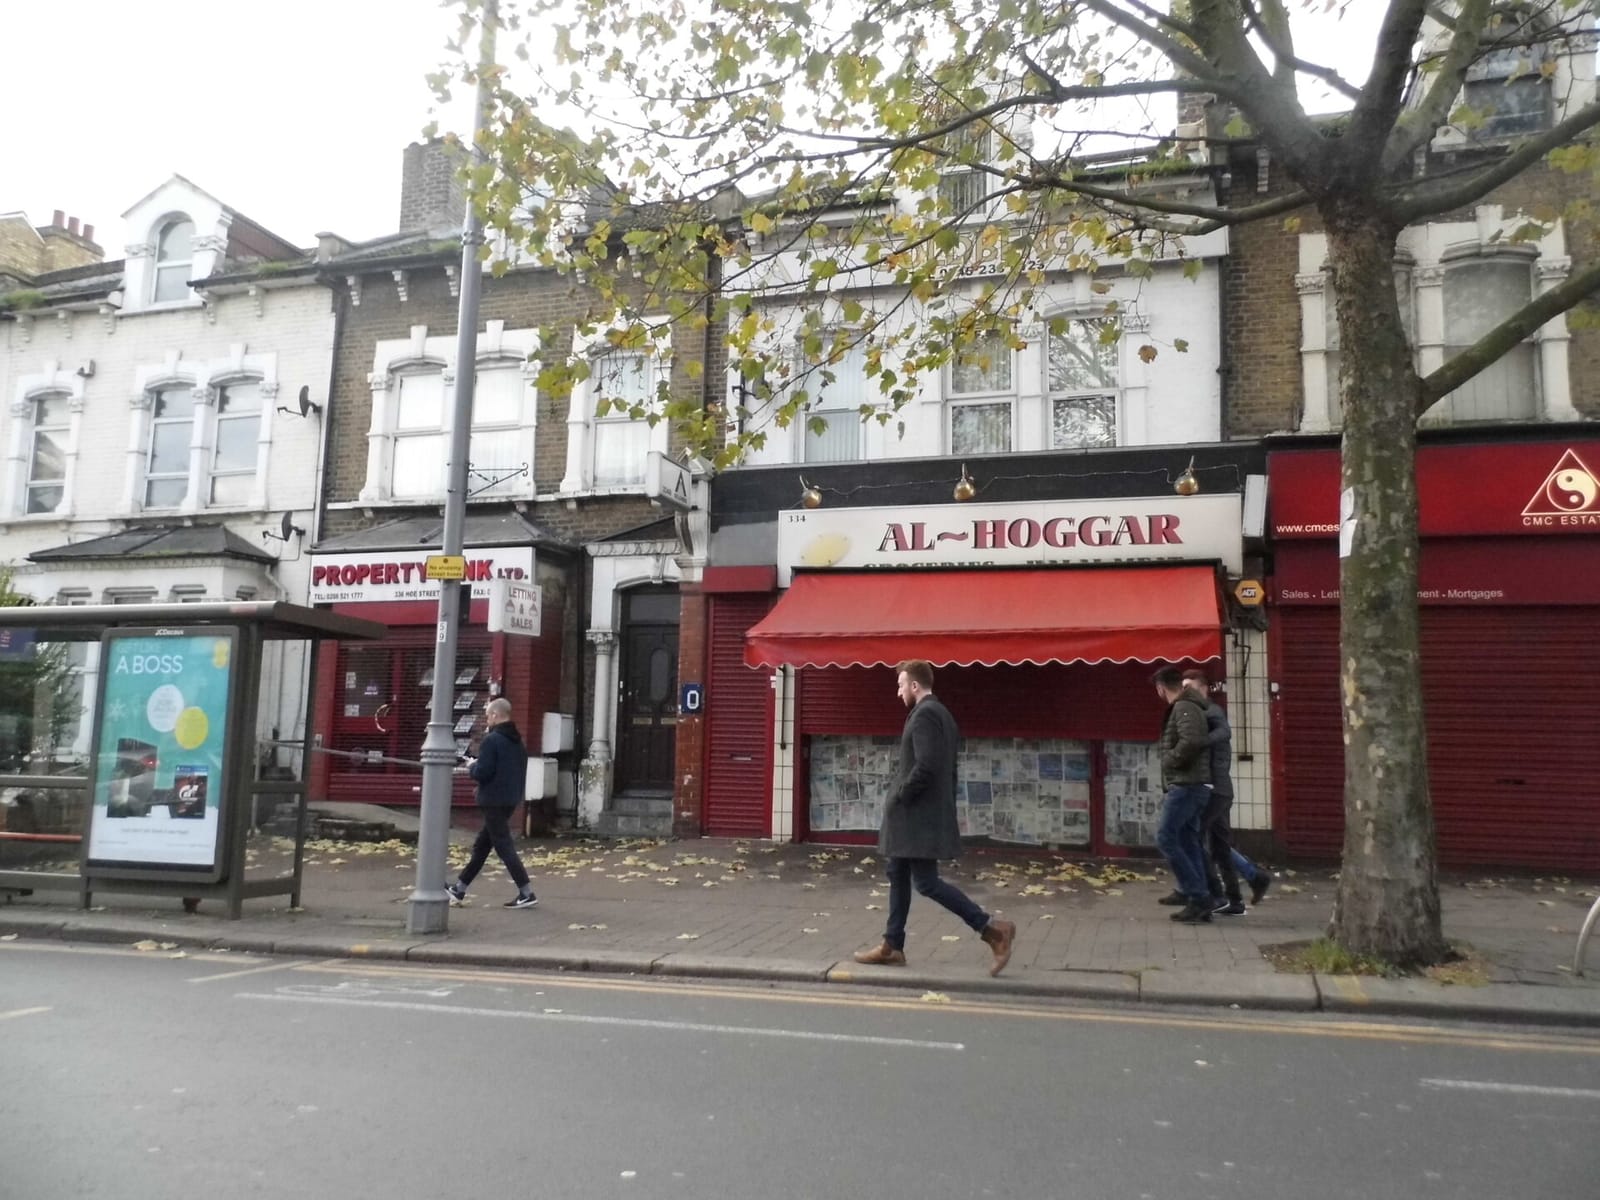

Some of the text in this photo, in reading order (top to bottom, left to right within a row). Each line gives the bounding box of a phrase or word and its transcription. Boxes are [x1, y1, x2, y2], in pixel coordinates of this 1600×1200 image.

[789, 514, 806, 523] 334
[1522, 515, 1600, 526] CMC ESTA
[1276, 524, 1340, 533] www.cmces
[312, 562, 427, 587] PROPERTY
[497, 567, 529, 580] LTD.
[418, 589, 440, 597] STREET
[508, 586, 537, 602] LETTING
[1281, 589, 1310, 599] Sales
[1320, 589, 1340, 599] Lett
[1447, 589, 1503, 600] Mortgages
[510, 616, 533, 630] SALES
[115, 654, 184, 674] A BOSS
